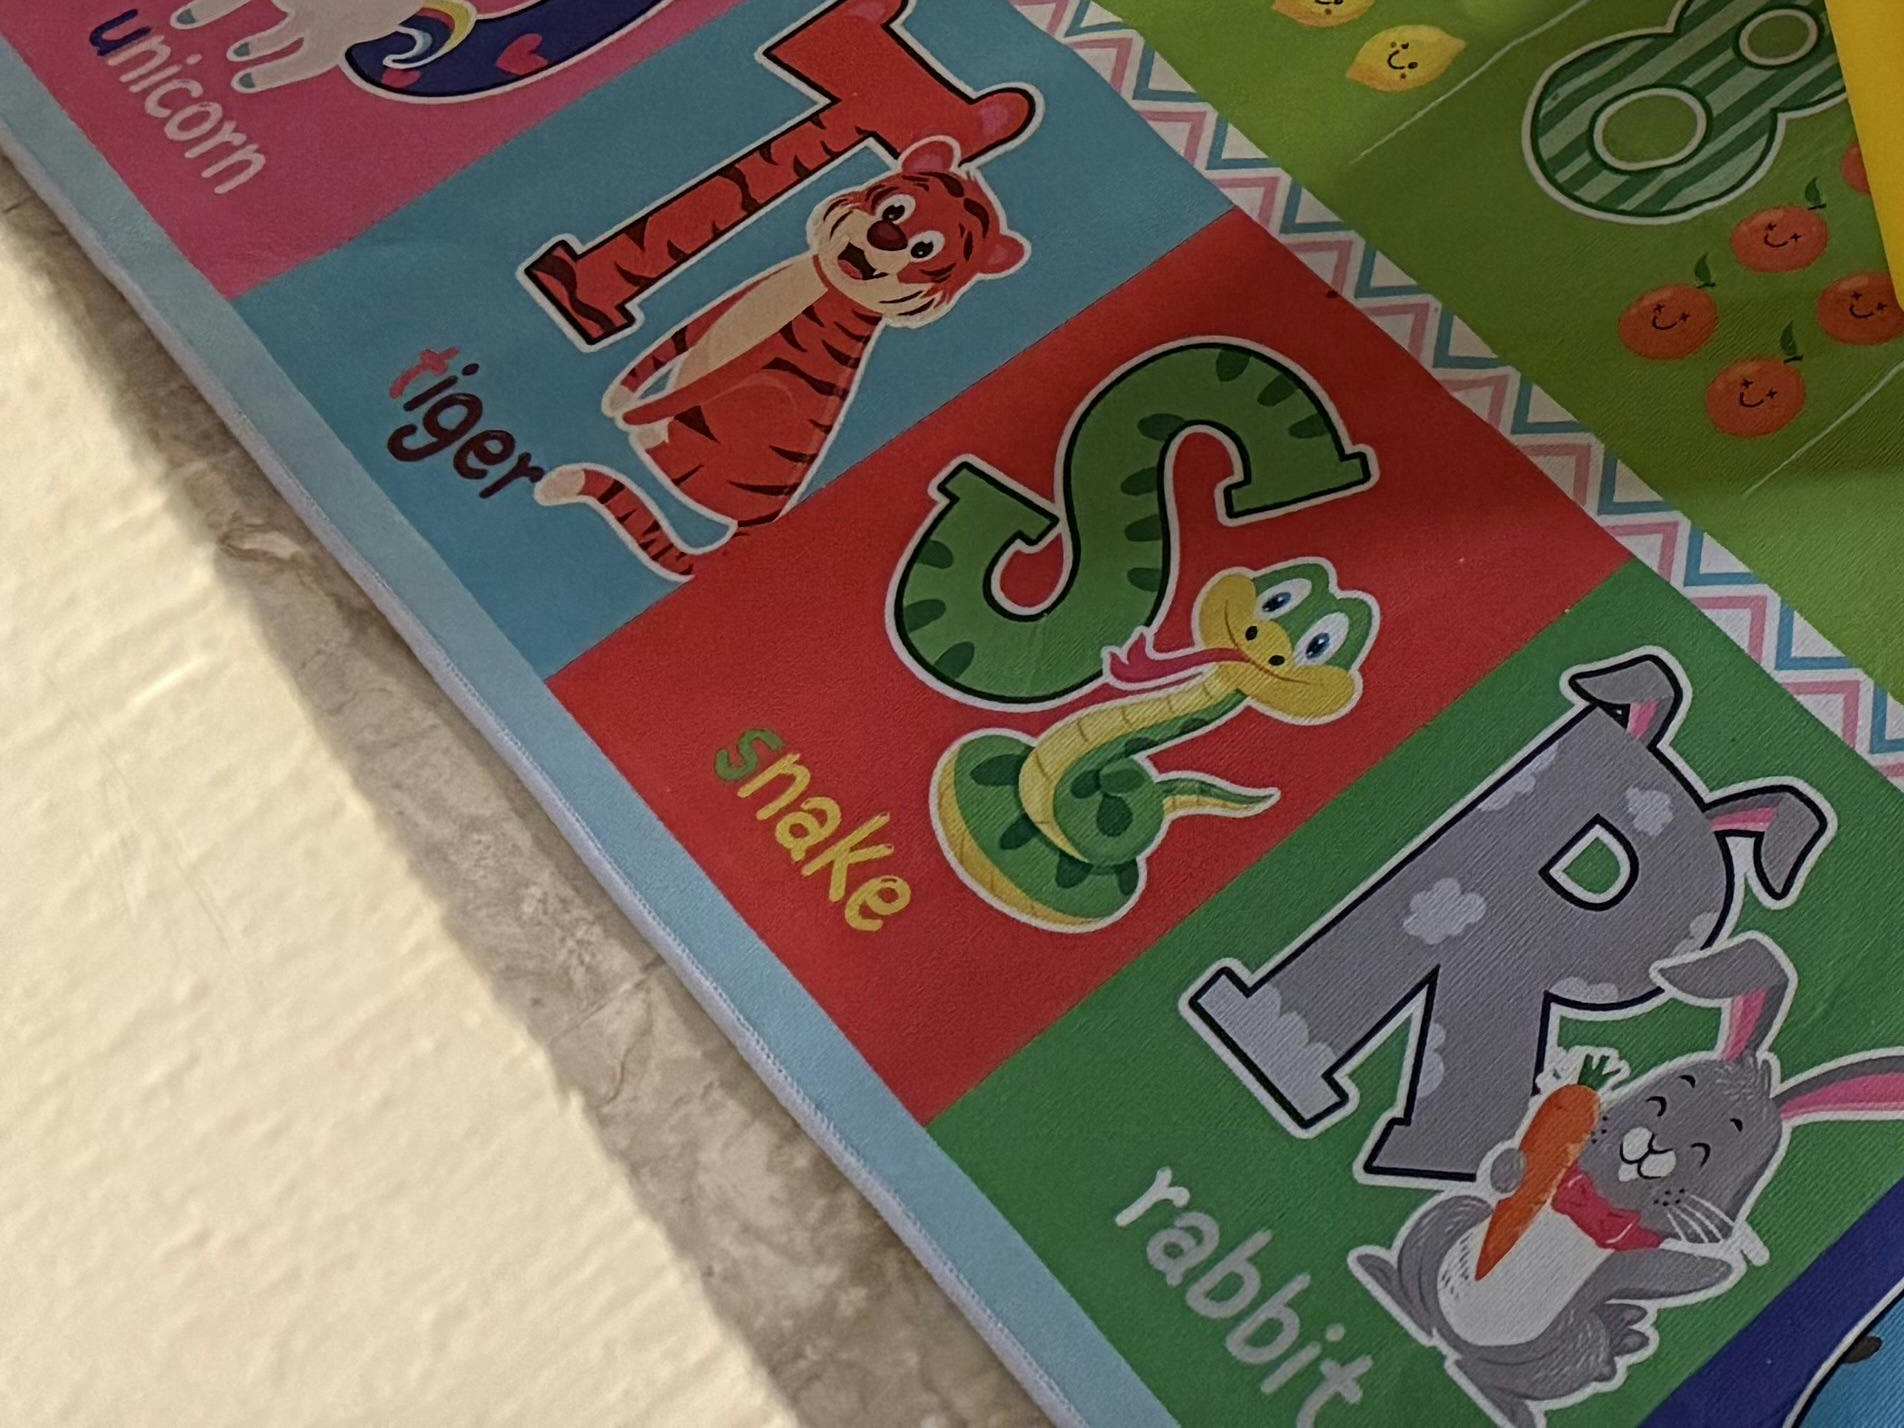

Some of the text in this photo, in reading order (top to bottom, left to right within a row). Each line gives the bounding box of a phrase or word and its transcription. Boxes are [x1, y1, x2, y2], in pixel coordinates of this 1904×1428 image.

[88, 7, 269, 197] unicorn
[386, 347, 544, 500] tiger
[886, 343, 1384, 710] S
[710, 726, 913, 927] snake
[1178, 645, 1838, 1185] R
[1112, 1164, 1374, 1428] rabbit
